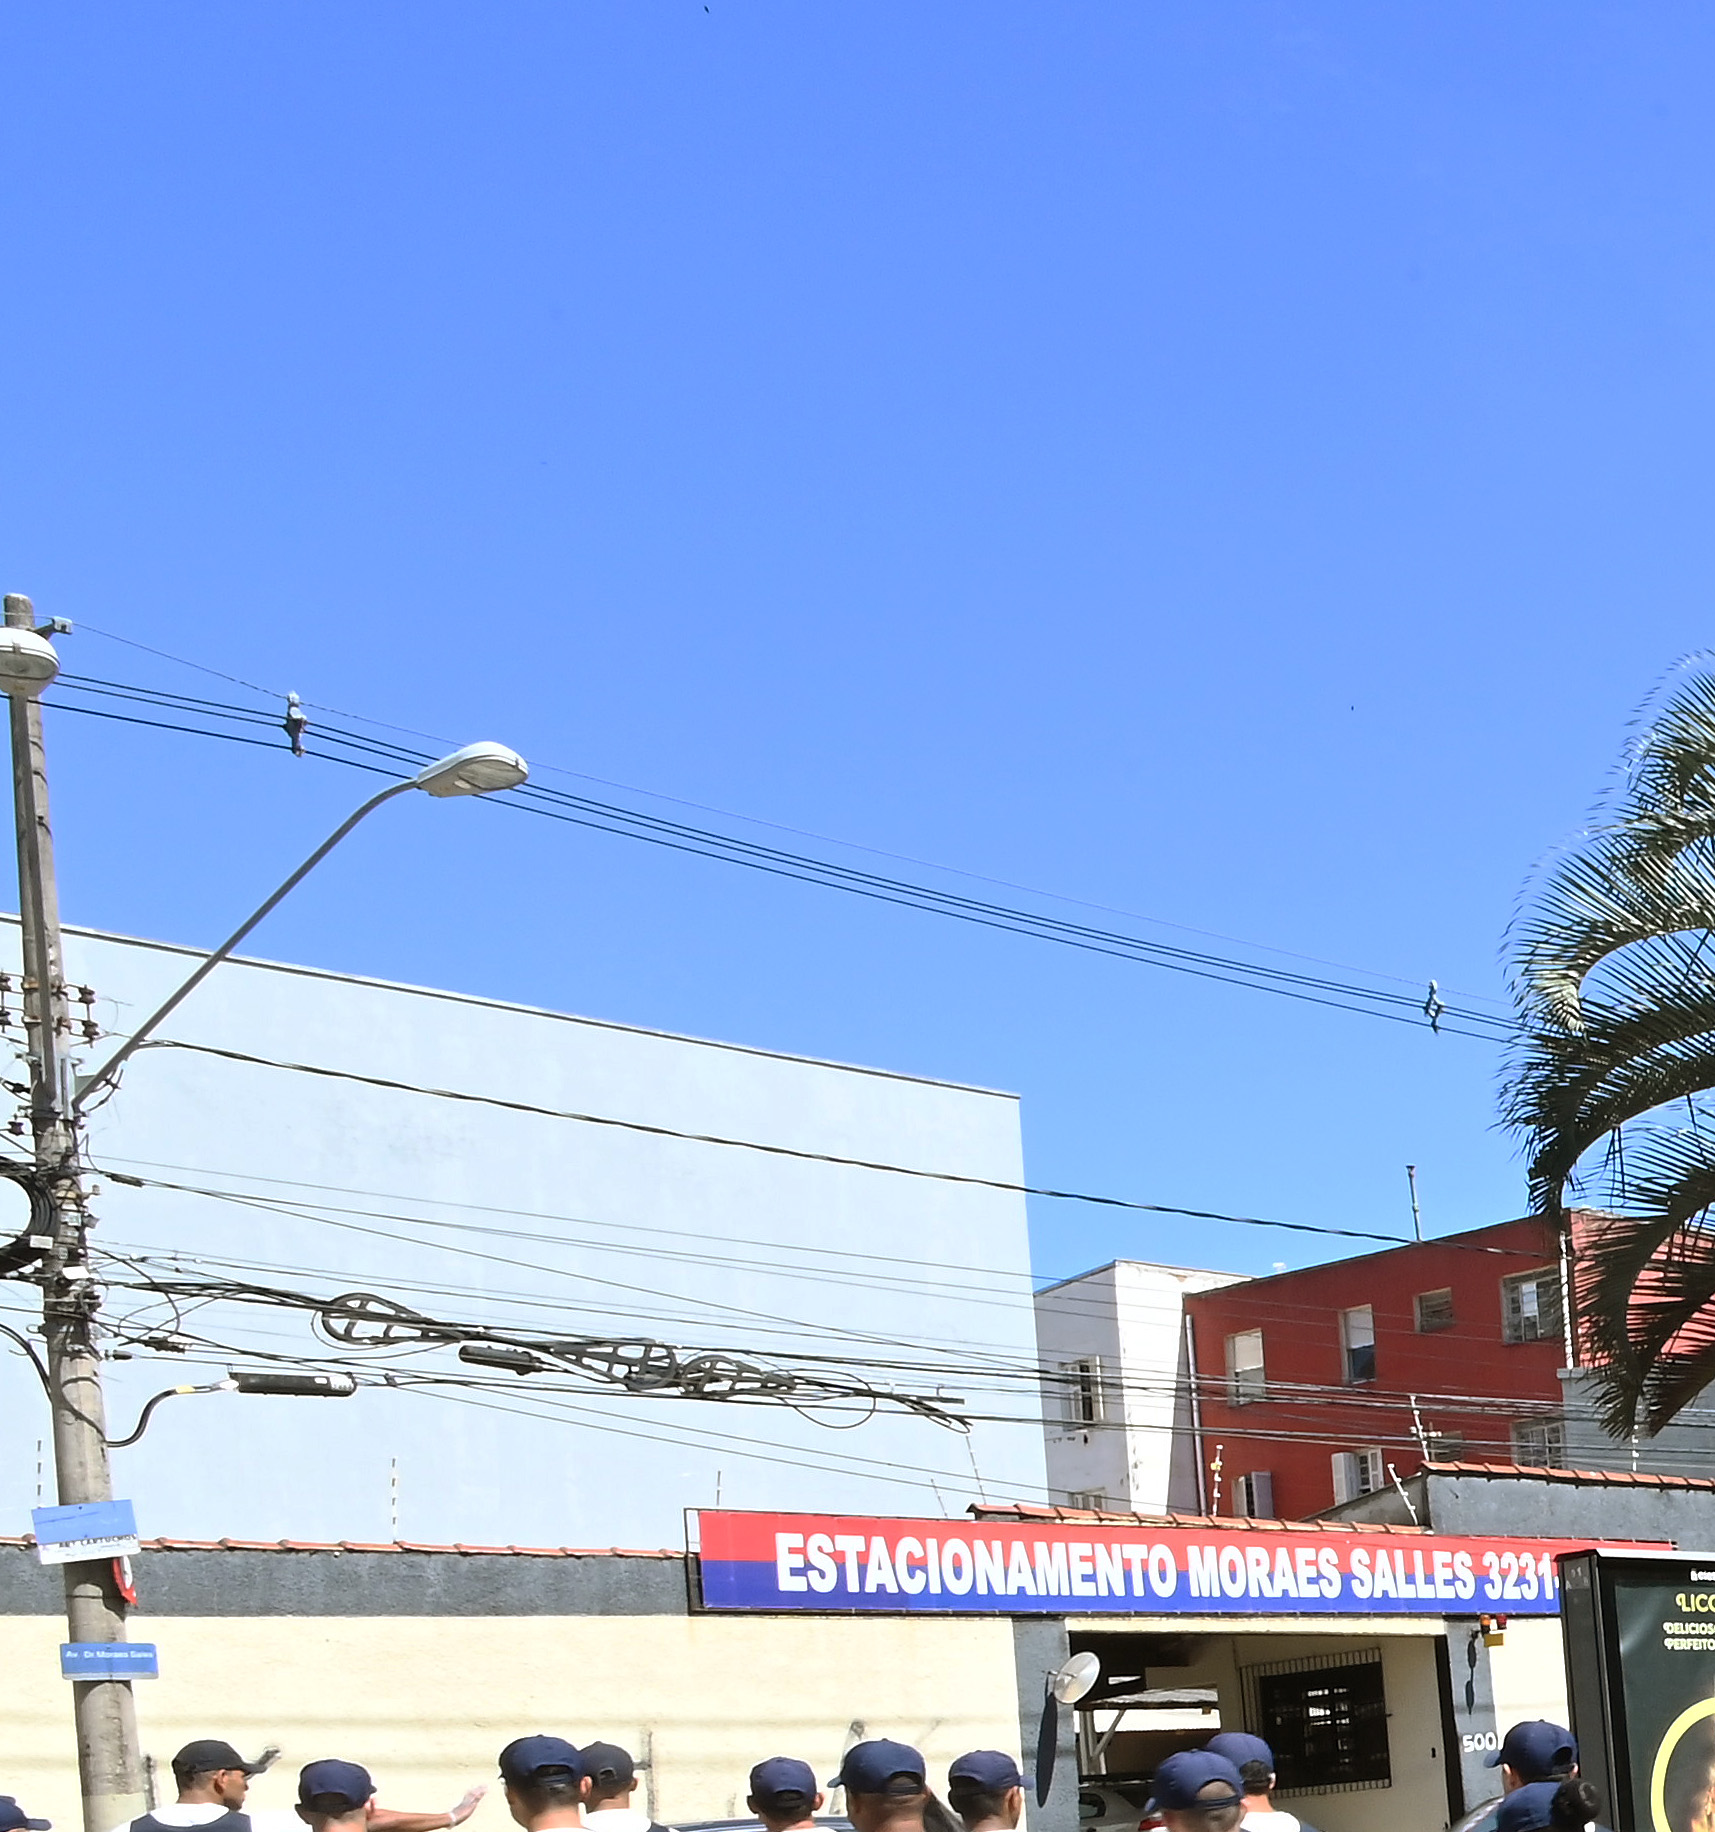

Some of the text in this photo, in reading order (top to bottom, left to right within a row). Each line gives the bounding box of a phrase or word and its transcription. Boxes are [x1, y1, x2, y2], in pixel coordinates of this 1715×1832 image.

[775, 1532, 1177, 1598] ESTACIONAMENTO
[1187, 1545, 1342, 1598] MORAES
[1350, 1549, 1475, 1601] SALLES
[1664, 1638, 1715, 1651] PERFEITO
